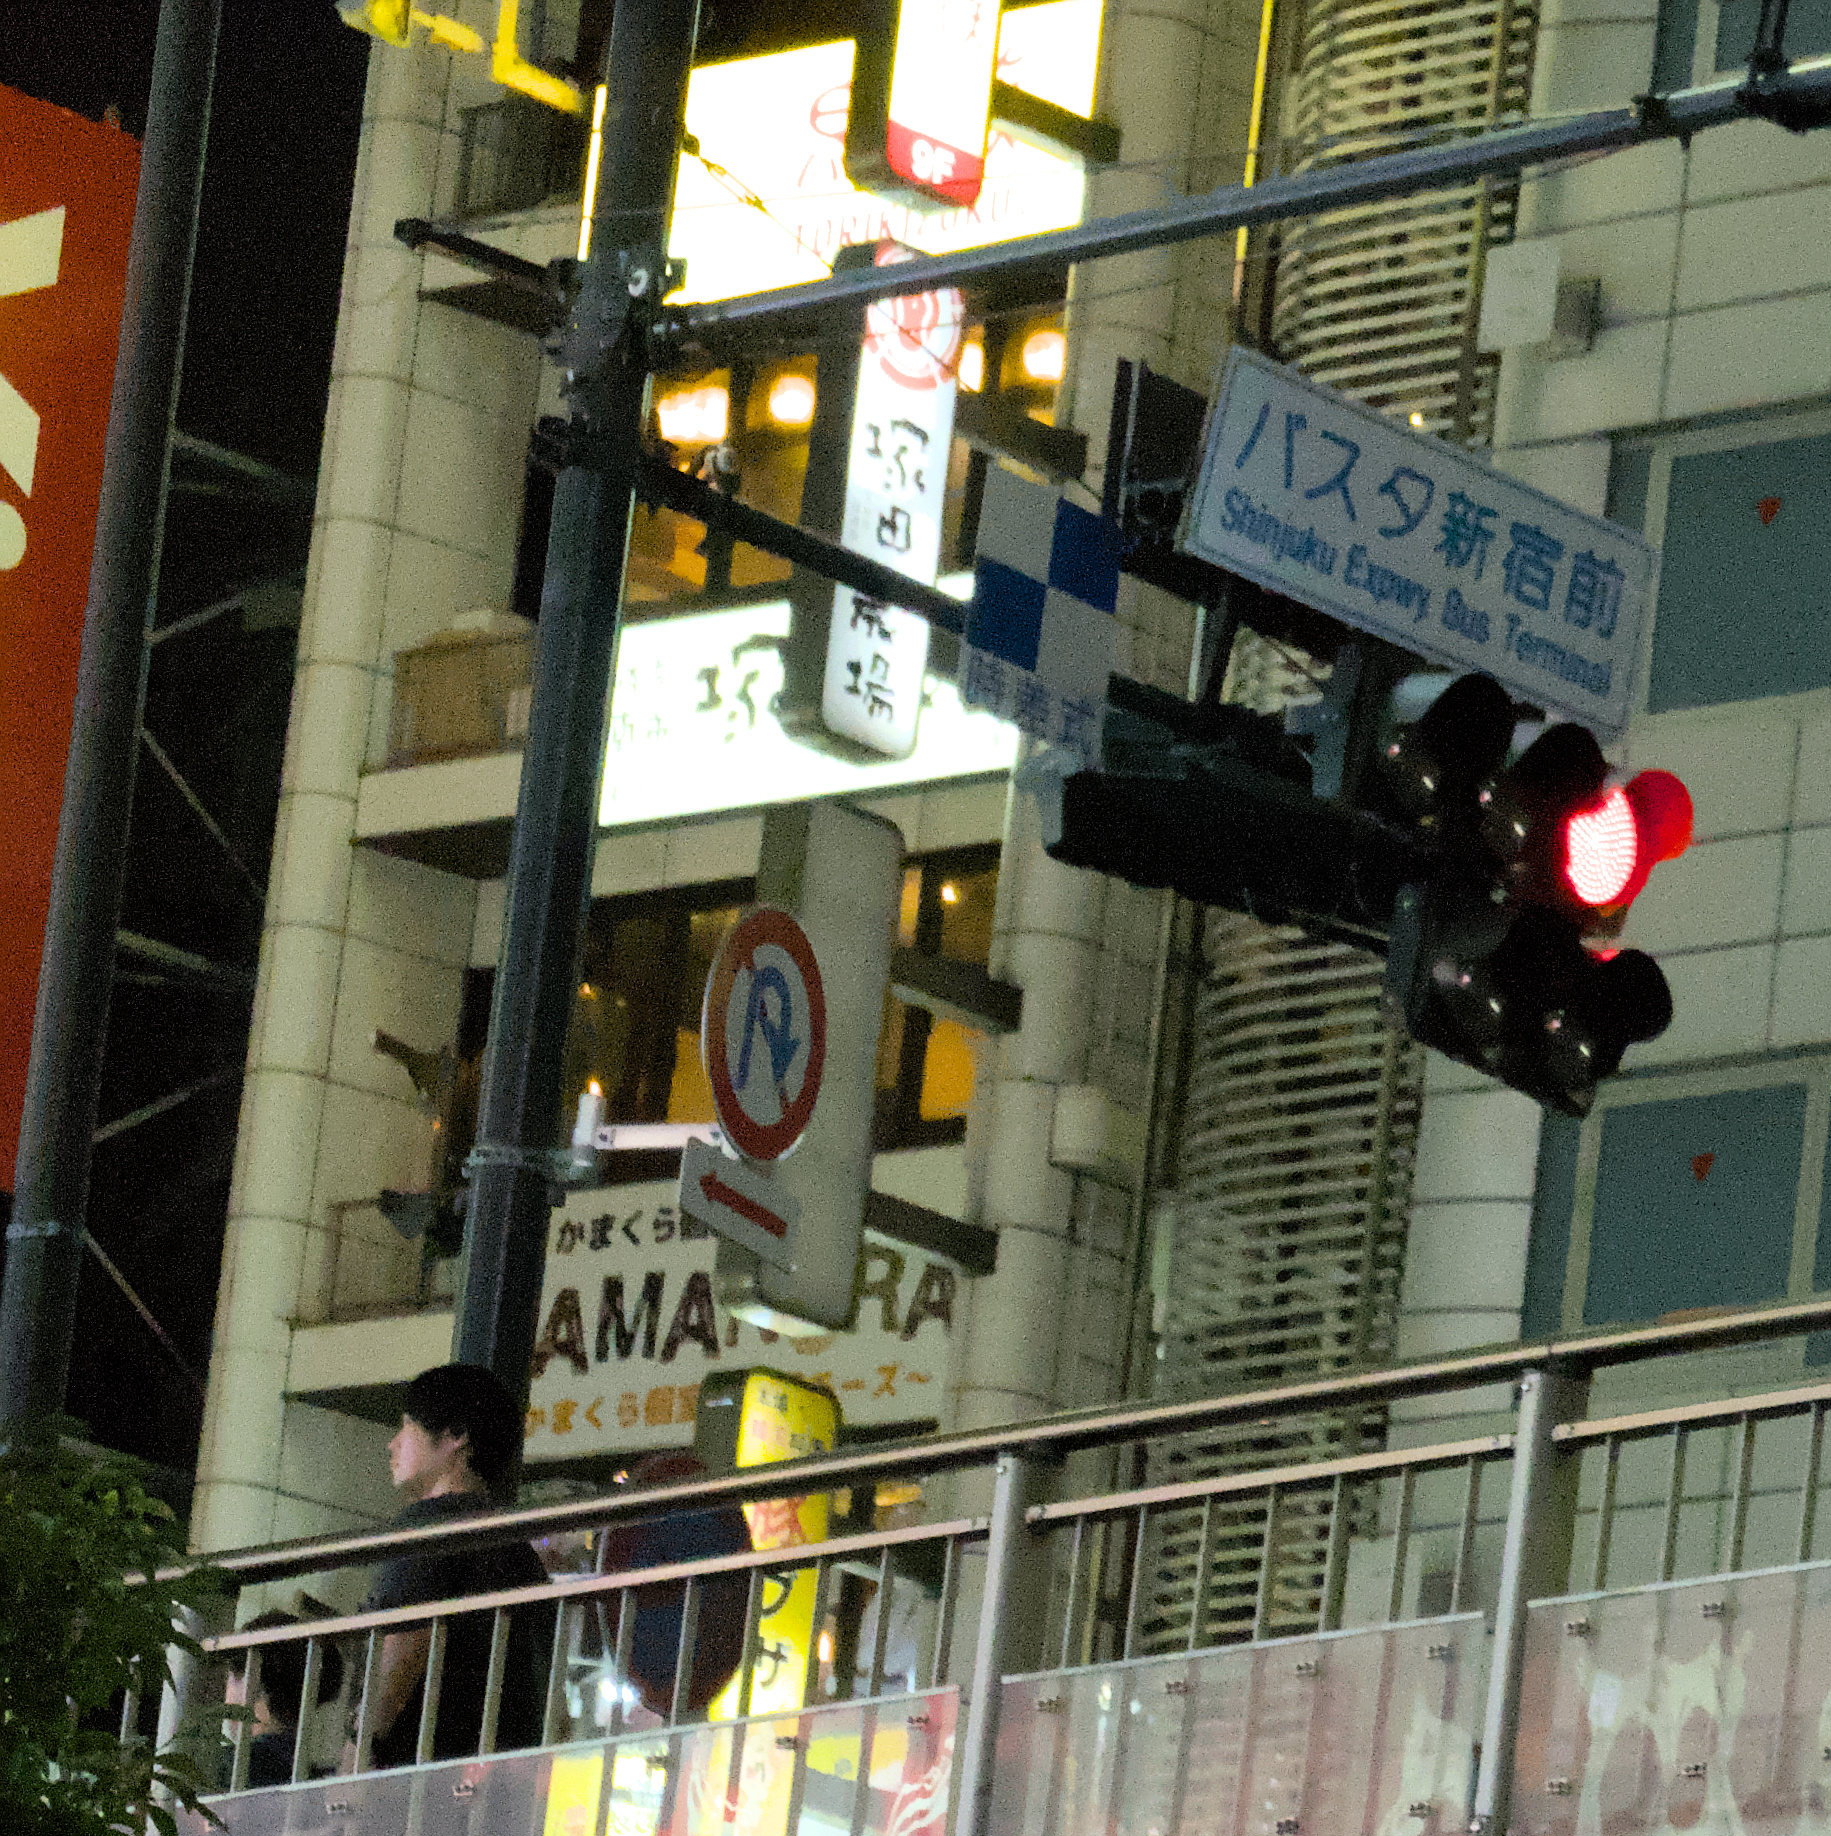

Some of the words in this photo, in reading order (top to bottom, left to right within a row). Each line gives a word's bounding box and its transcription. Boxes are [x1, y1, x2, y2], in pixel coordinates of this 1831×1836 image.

[912, 139, 956, 185] 9F
[1221, 486, 1338, 577] Shinjuku
[1440, 586, 1490, 645] Bus
[1504, 612, 1612, 697] Terminal
[1235, 401, 1627, 640] バスタ新宿前
